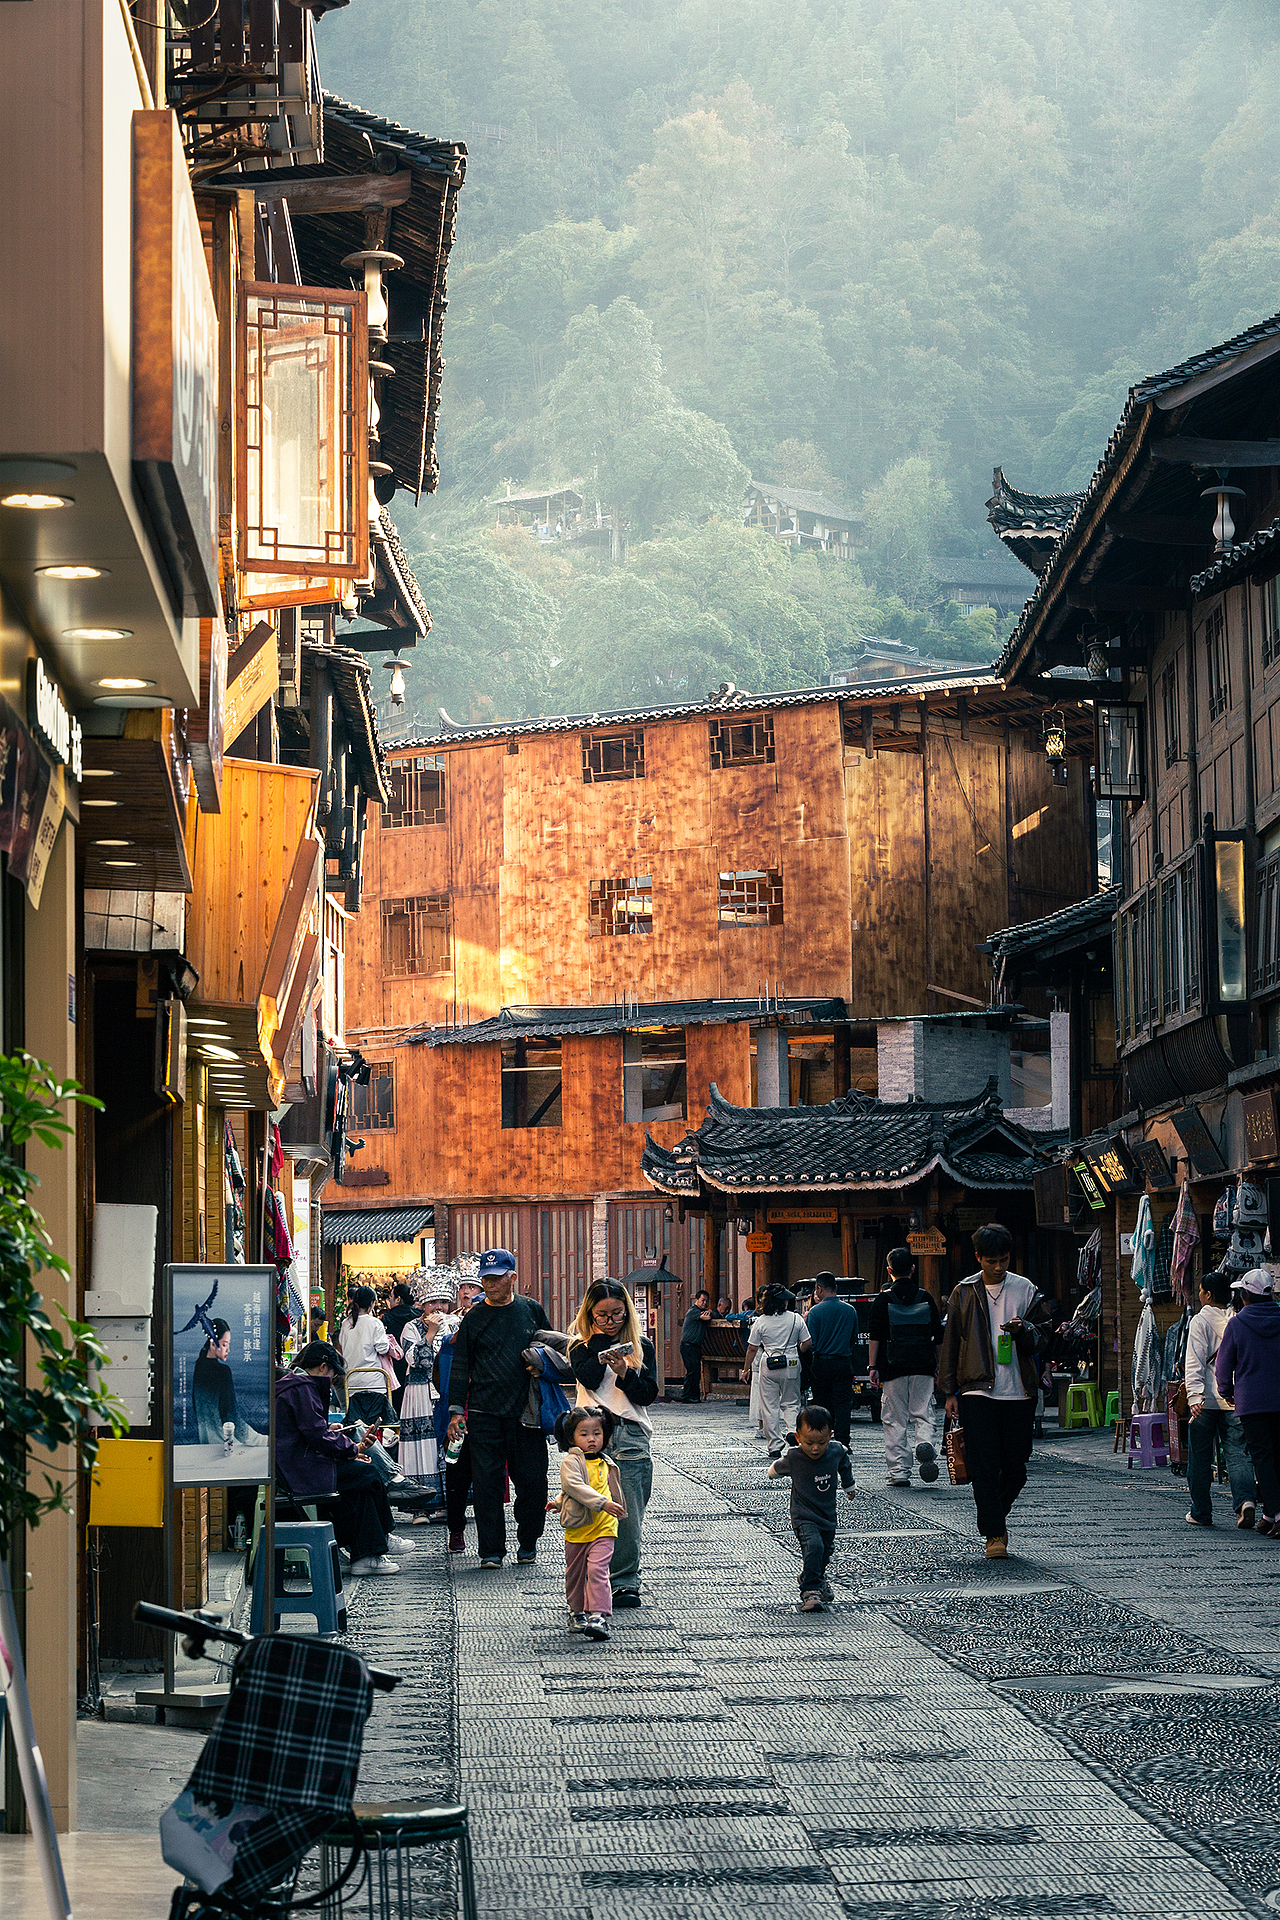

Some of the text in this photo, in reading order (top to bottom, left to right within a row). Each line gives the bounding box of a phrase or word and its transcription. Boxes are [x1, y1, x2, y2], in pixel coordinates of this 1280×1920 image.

[243, 1303, 252, 1362] 茶香一脉承
[946, 1433, 957, 1485] Cotti Coffee
